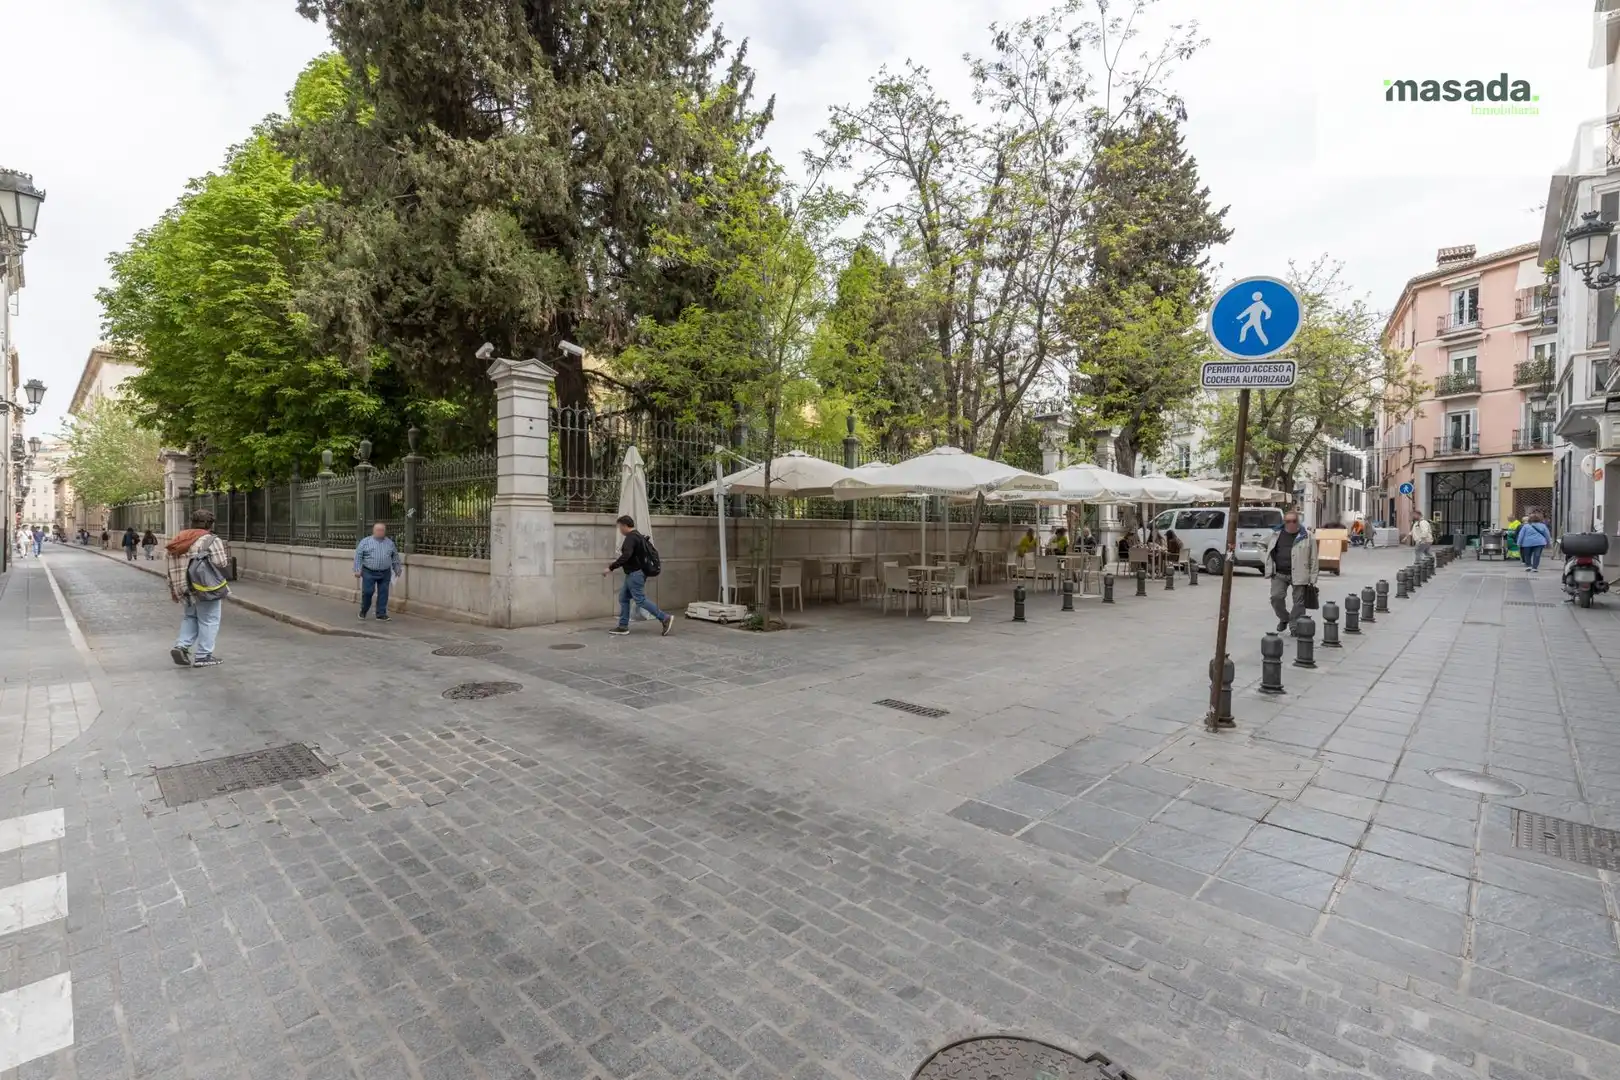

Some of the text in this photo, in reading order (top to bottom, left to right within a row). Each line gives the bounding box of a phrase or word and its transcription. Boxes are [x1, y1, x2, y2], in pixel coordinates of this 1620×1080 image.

[1207, 364, 1292, 374] PERMITIDO ACCESO A
[1206, 375, 1291, 384] COCHERA AUTORIZADA
